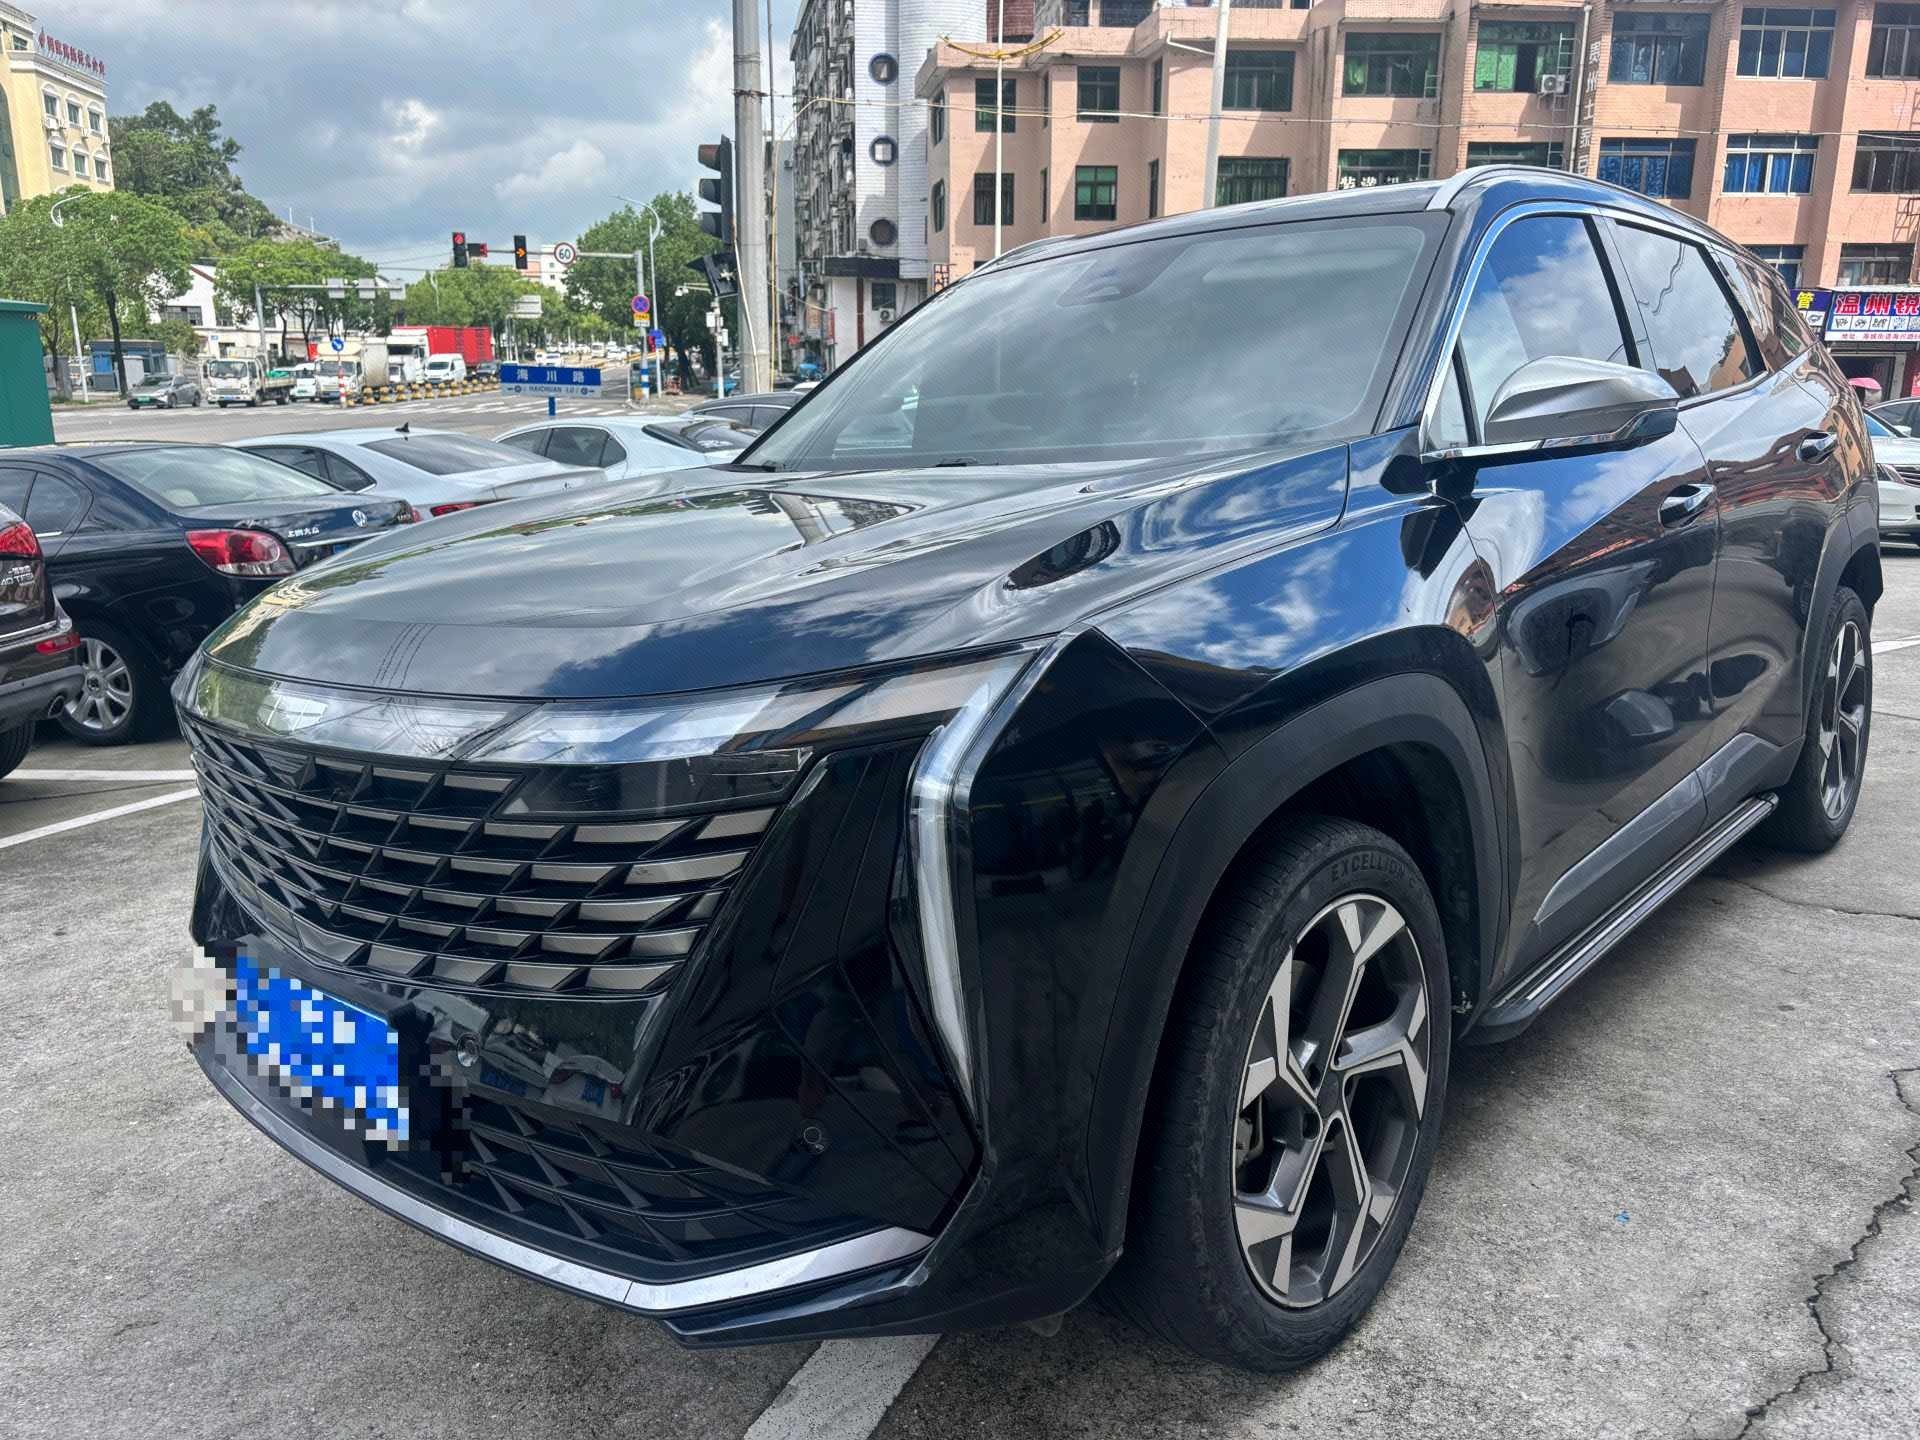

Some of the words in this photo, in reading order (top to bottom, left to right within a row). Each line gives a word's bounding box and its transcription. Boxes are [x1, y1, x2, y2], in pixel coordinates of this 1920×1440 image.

[559, 249, 570, 259] 60
[1797, 291, 1814, 310] 管
[1834, 294, 1920, 315] 温州锐
